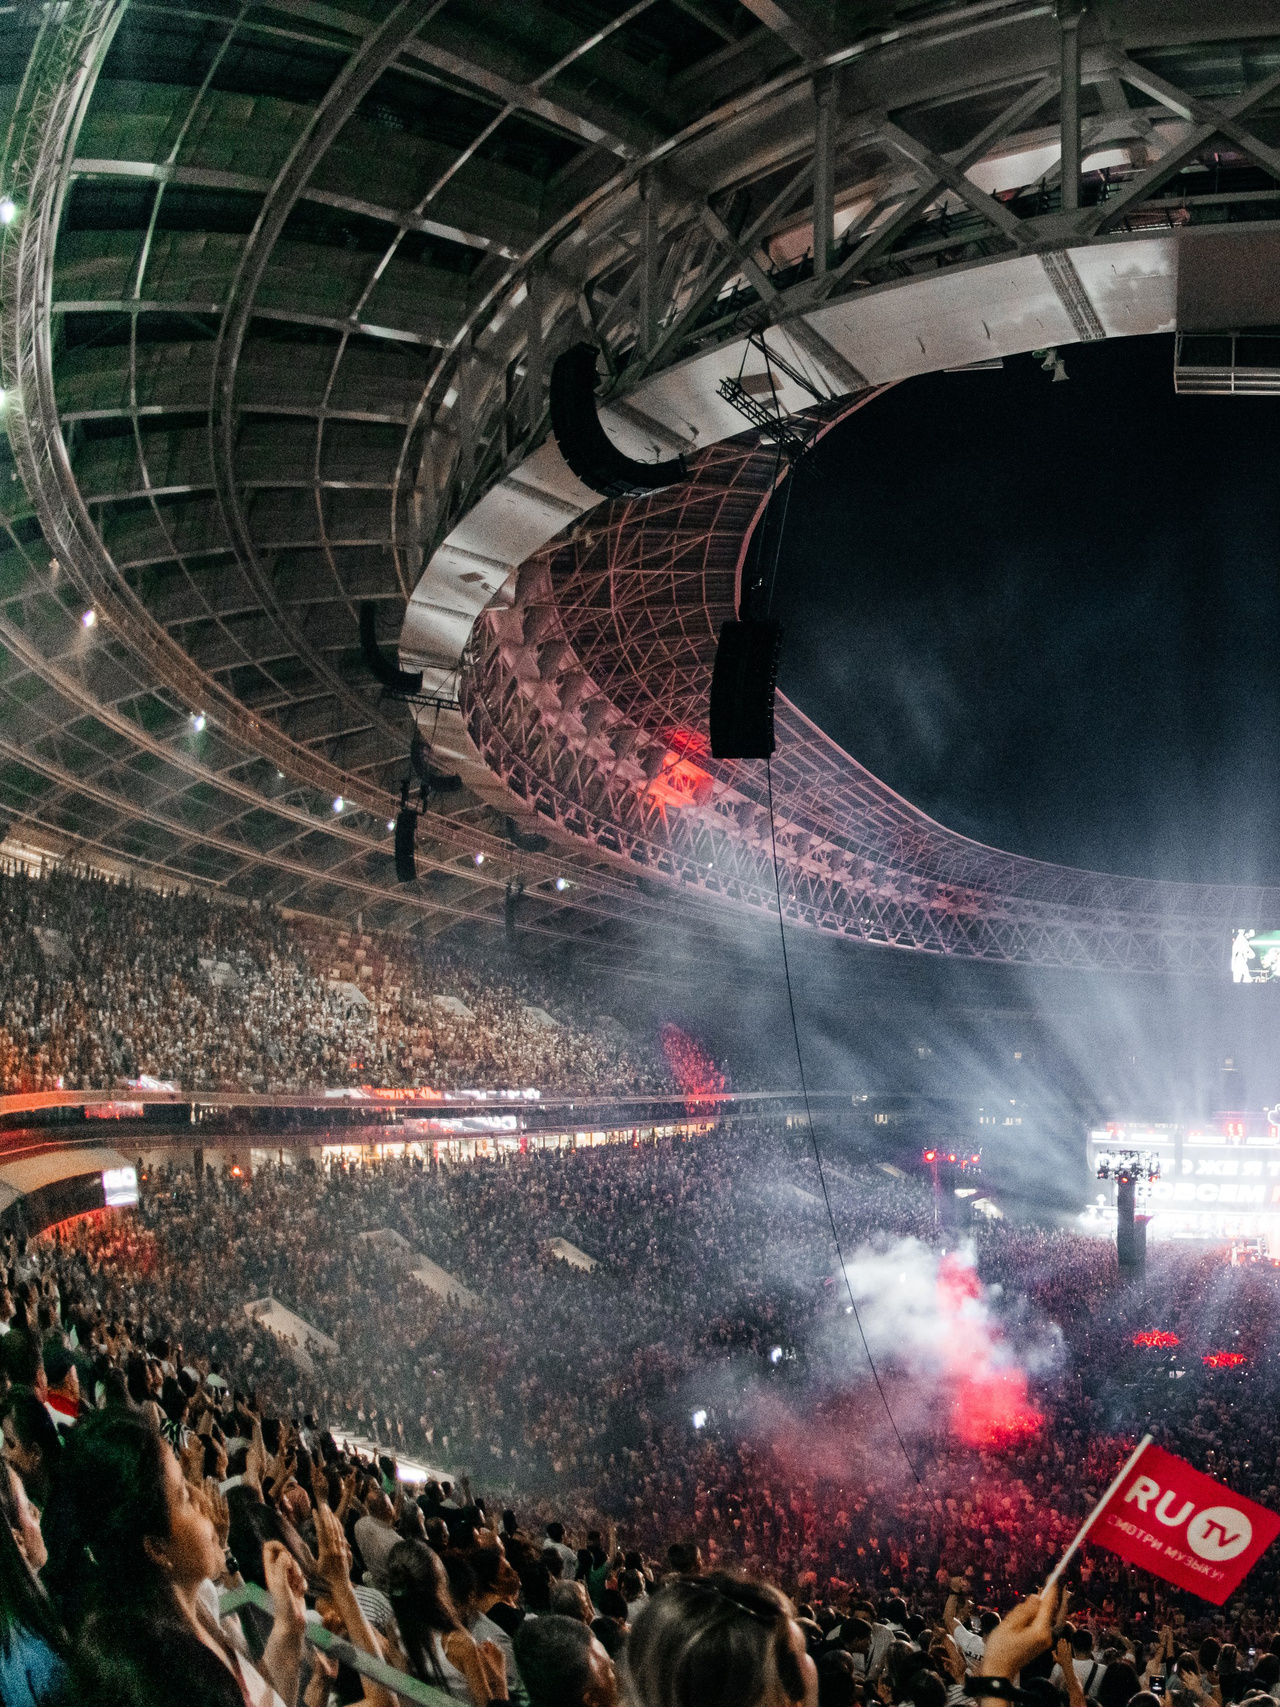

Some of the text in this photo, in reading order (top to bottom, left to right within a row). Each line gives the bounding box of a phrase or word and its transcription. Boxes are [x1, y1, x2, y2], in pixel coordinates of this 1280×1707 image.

[1107, 1514, 1163, 1551] СМОТРИ
[1124, 1475, 1241, 1548] RU TV
